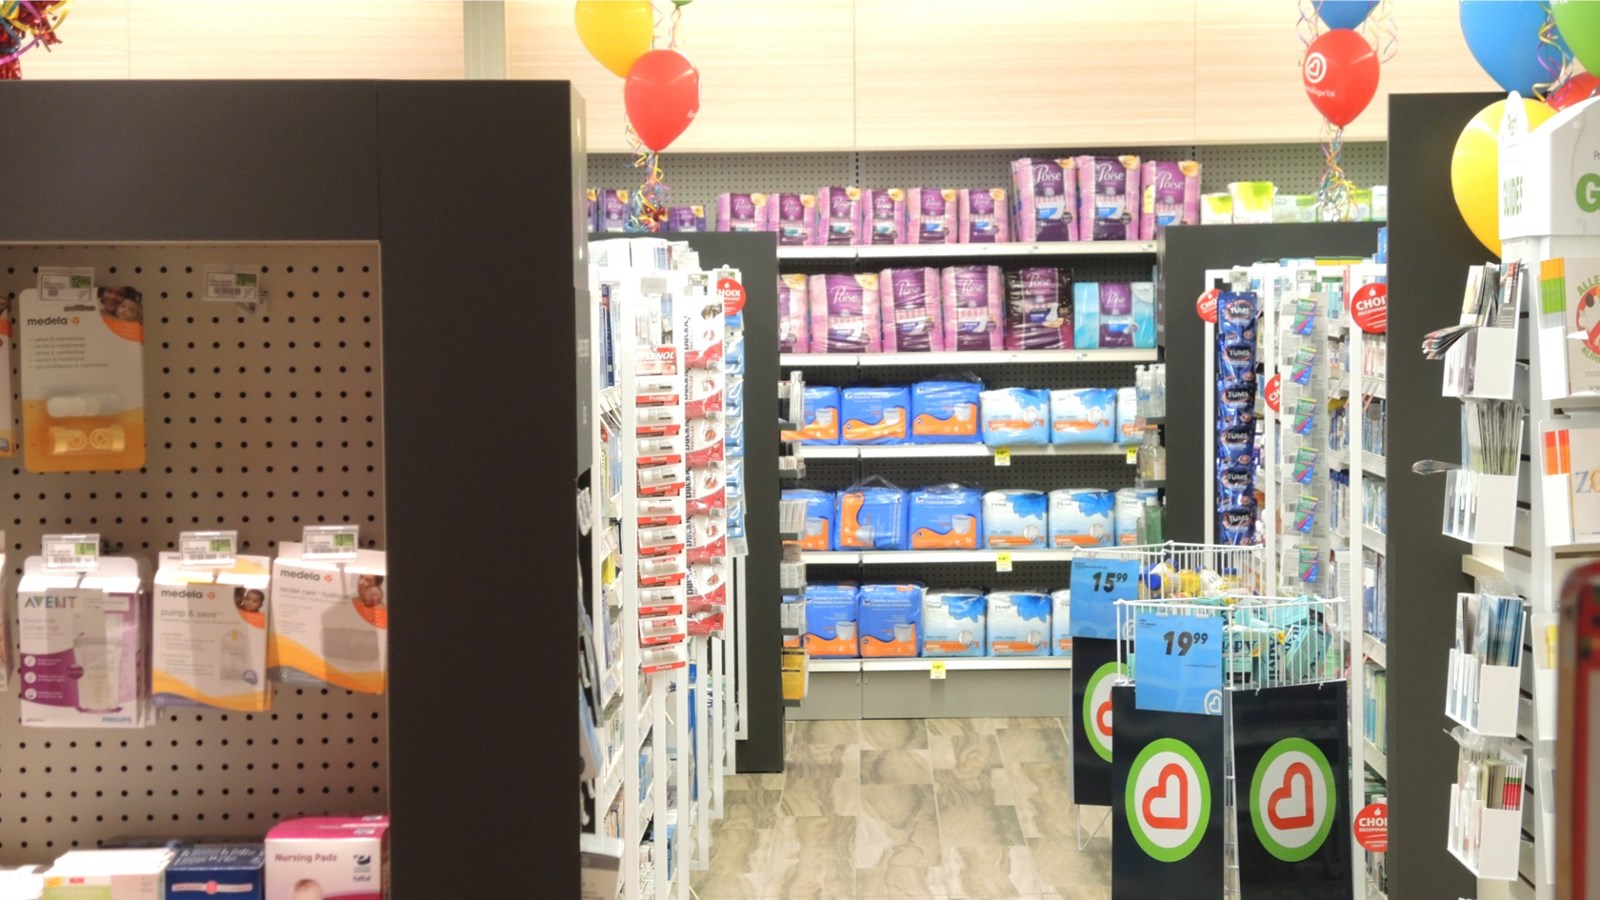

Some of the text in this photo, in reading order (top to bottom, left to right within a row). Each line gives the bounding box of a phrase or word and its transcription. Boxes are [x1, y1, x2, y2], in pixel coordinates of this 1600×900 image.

[1155, 171, 1185, 190] Poise
[1356, 295, 1386, 311] CHOI
[27, 316, 68, 326] medela
[280, 568, 321, 581] medela
[160, 589, 203, 599] medela
[24, 596, 77, 609] AVENT
[160, 609, 186, 618] pump
[188, 610, 195, 618] &
[1359, 817, 1387, 827] CHOI
[275, 853, 337, 863] Nursing Pads
